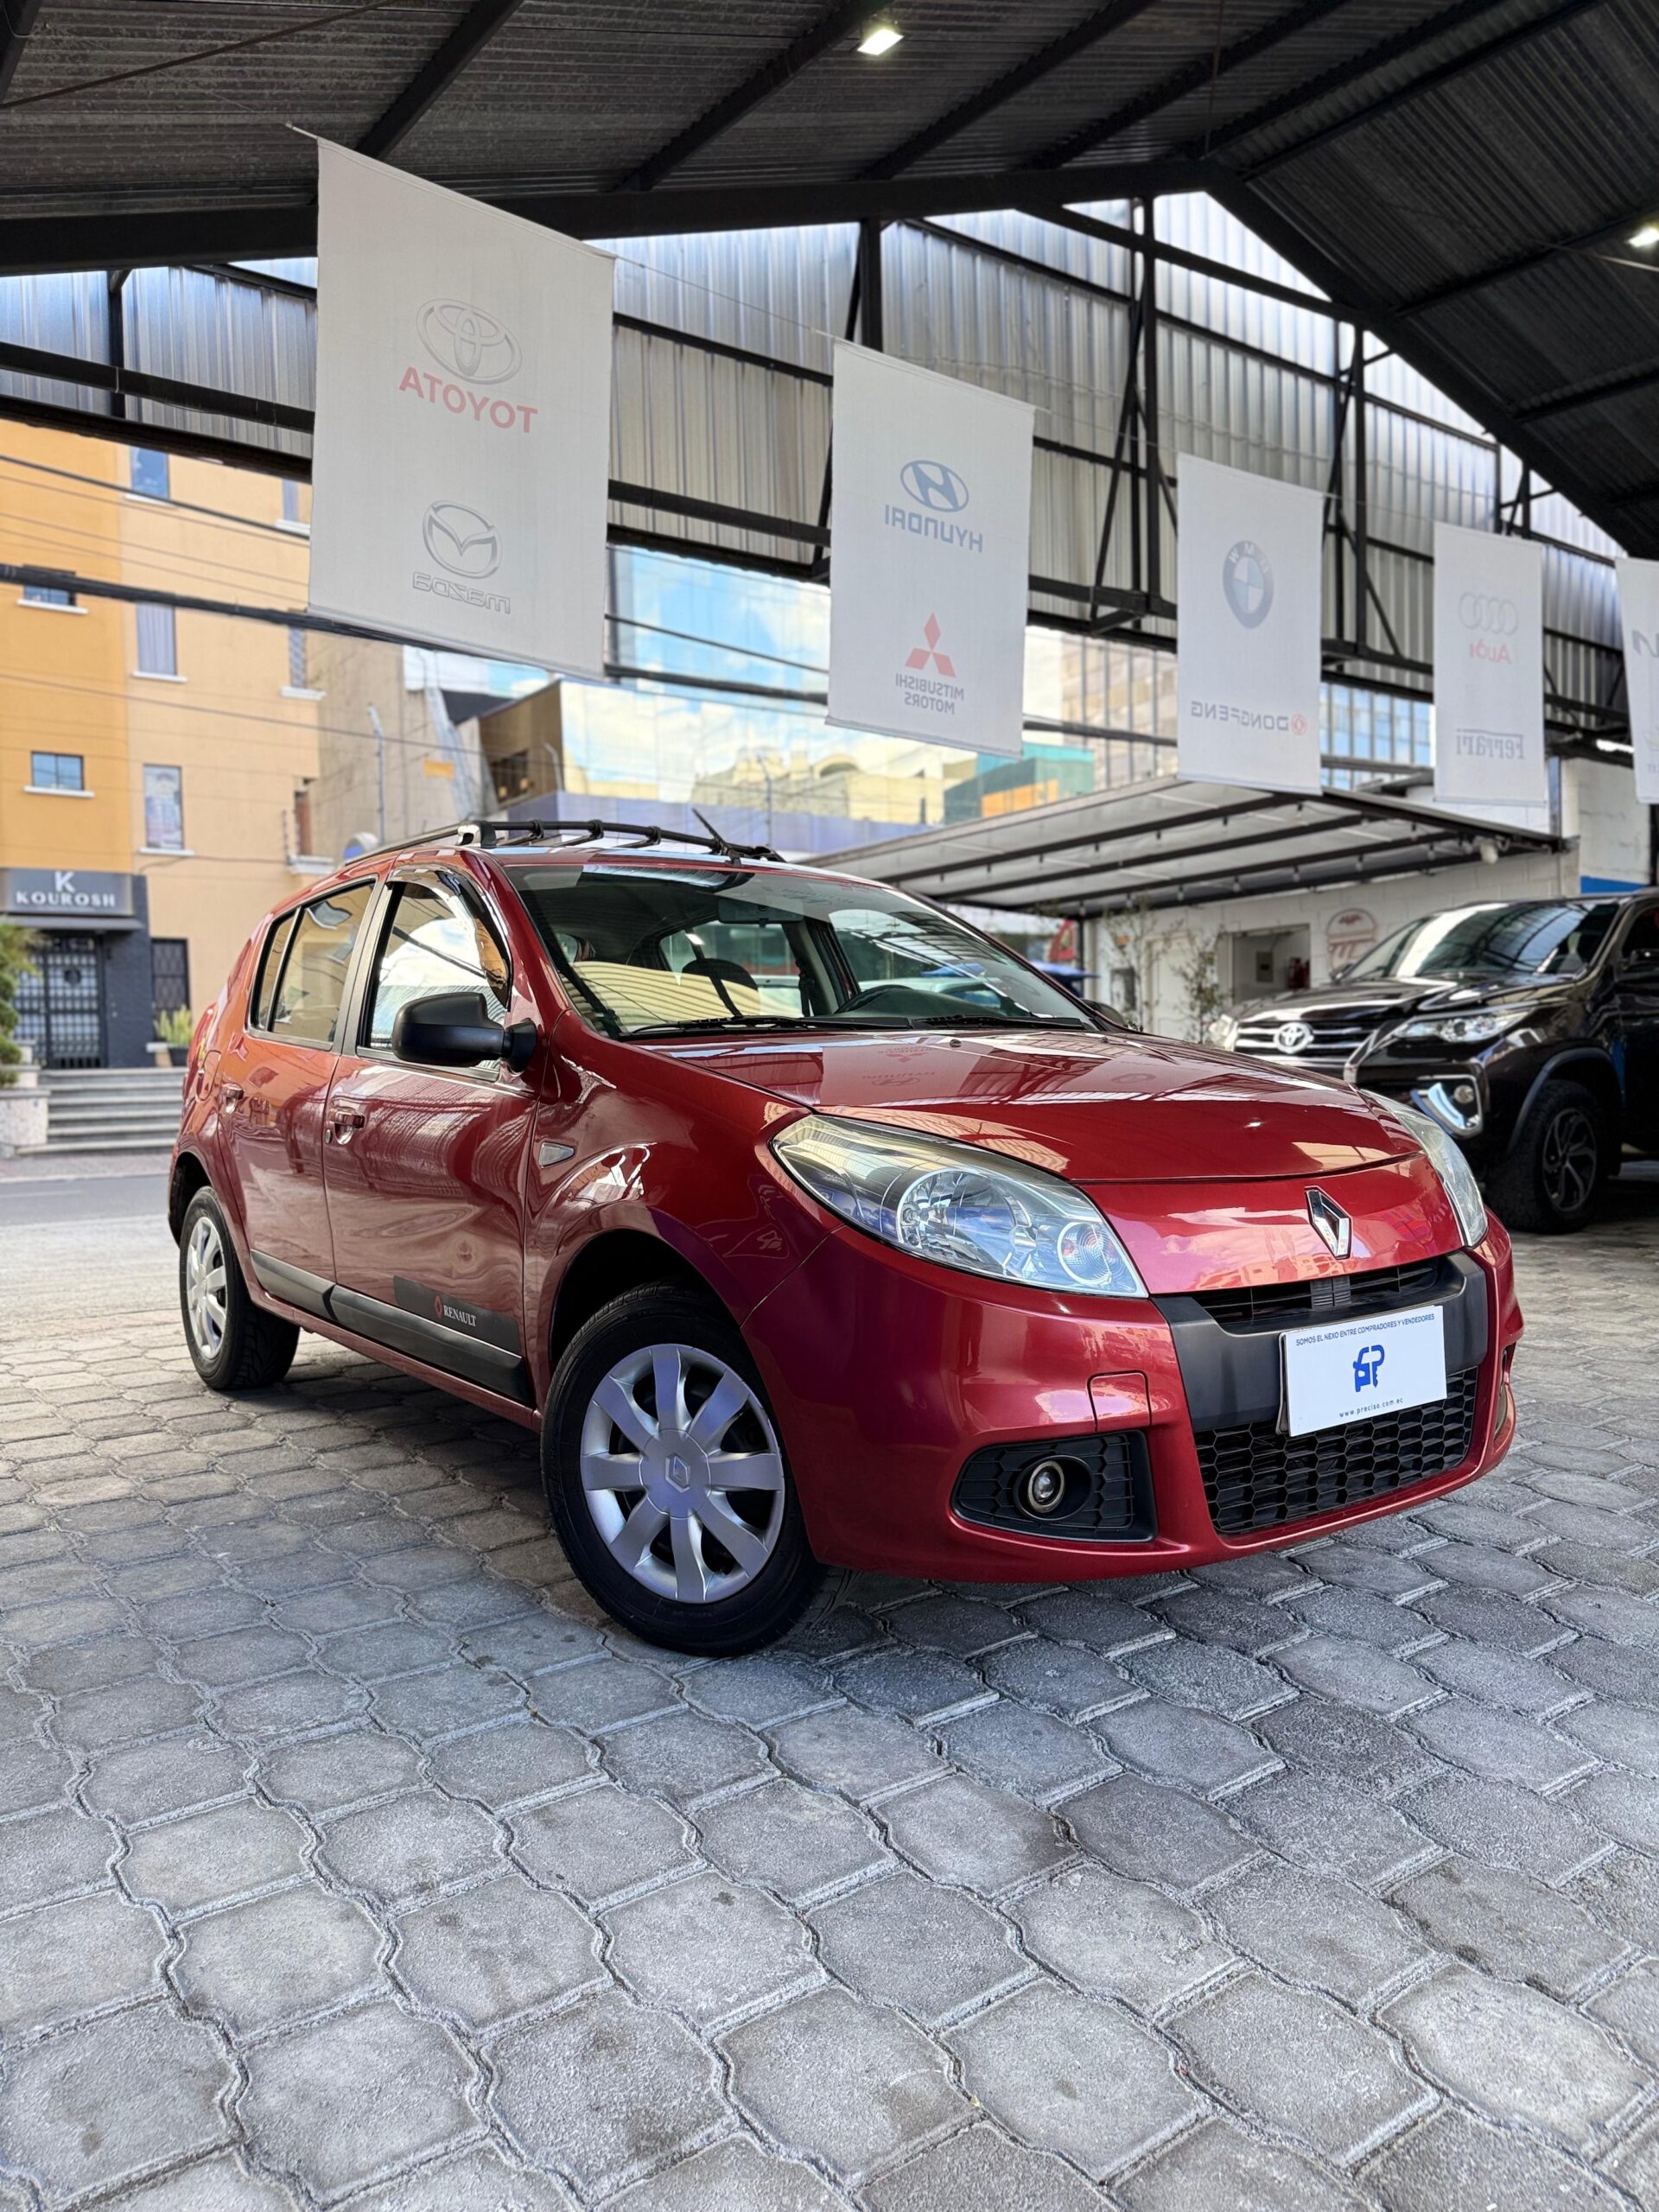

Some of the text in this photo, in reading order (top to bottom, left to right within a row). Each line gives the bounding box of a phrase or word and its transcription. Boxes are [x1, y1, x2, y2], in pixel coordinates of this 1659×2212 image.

[54, 870, 75, 893] K
[16, 891, 116, 907] KOUROSH
[443, 1305, 477, 1327] RENAULT
[1295, 1335, 1317, 1346] SOMOS
[1325, 1332, 1339, 1340] NEXO
[1339, 1328, 1357, 1338] ENTRE
[1357, 1320, 1397, 1334] COMPRADORES
[1402, 1313, 1435, 1326] VENDEDORES
[1339, 1398, 1404, 1418] www.preciso.com.ec
